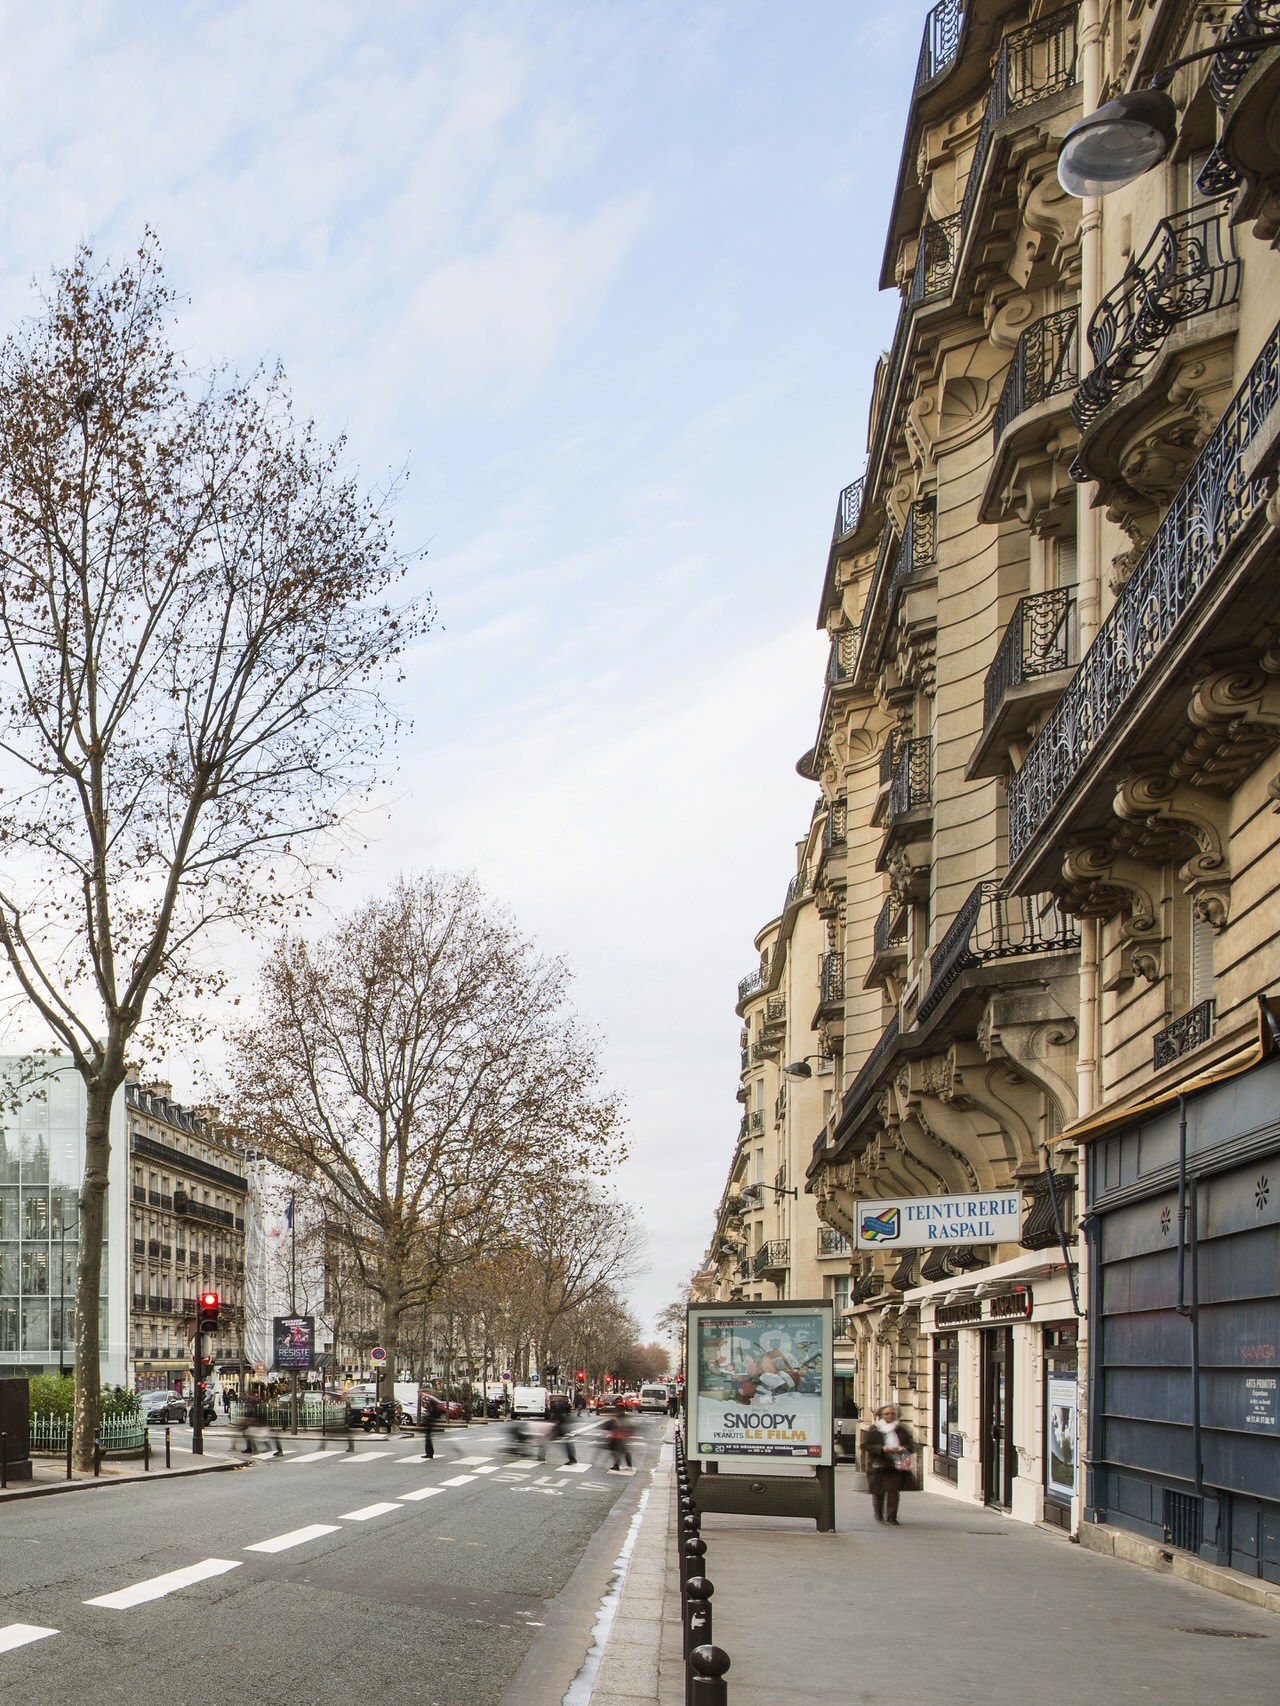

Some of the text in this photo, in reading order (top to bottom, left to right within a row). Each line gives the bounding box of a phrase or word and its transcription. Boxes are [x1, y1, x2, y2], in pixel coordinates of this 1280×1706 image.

[905, 1199, 1017, 1221] TEINTURERIE
[928, 1221, 995, 1240] RASPAIL
[723, 1412, 796, 1429] SNOOPY
[745, 1430, 807, 1440] LE FILM
